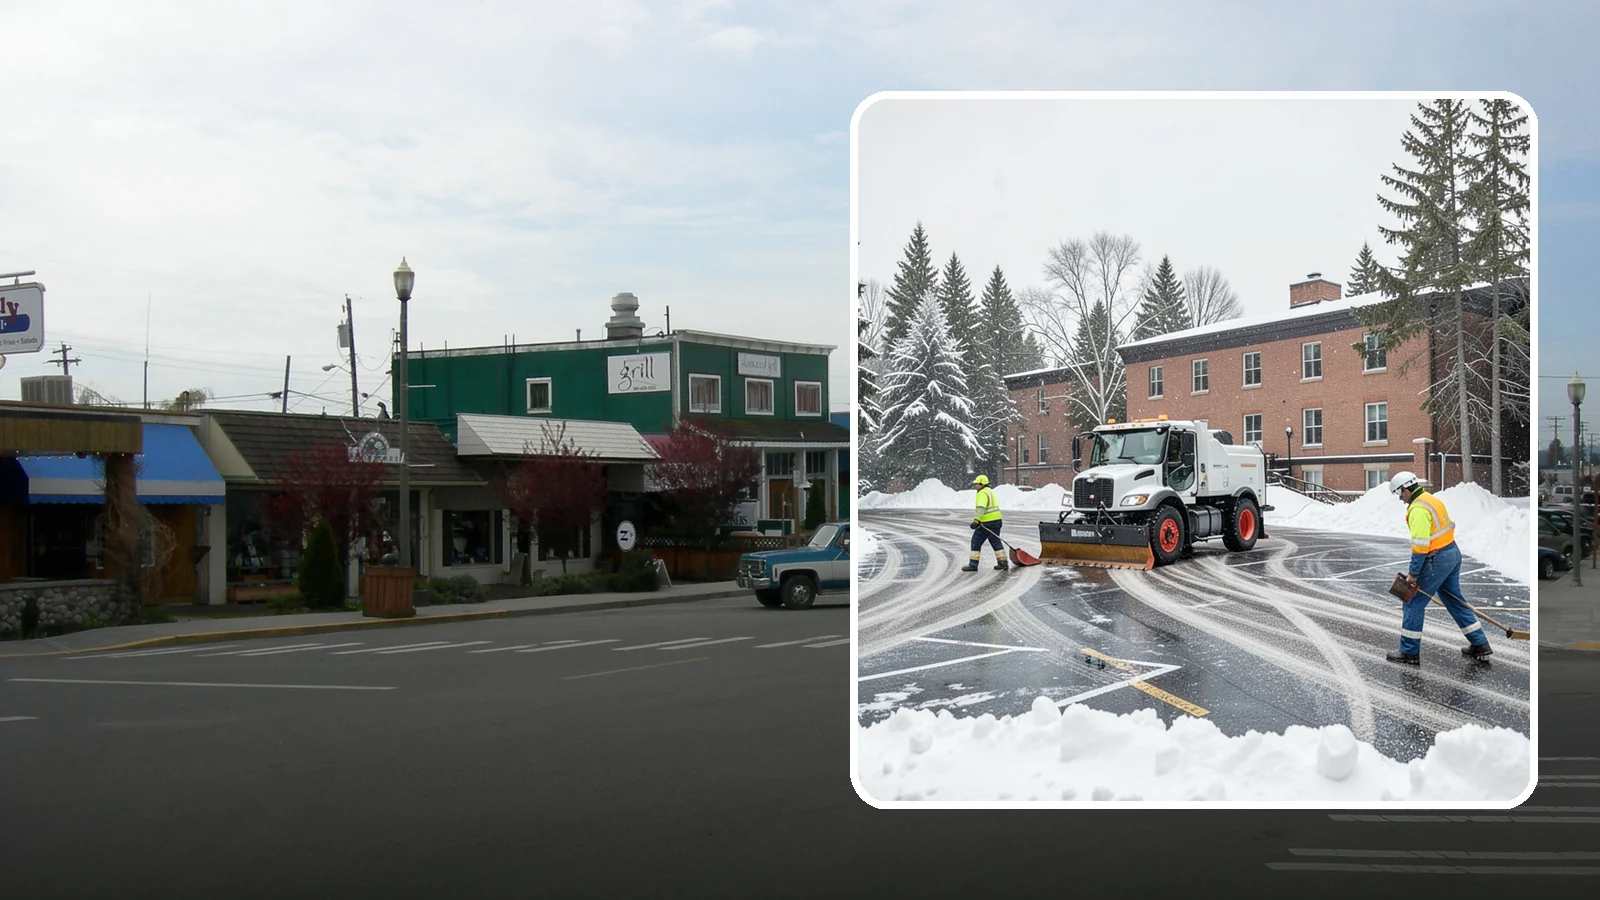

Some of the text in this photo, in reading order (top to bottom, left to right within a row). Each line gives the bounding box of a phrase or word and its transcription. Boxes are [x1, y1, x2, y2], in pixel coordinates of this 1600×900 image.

[3, 338, 16, 346] Fries
[20, 337, 38, 345] Salads
[618, 356, 655, 391] grill
